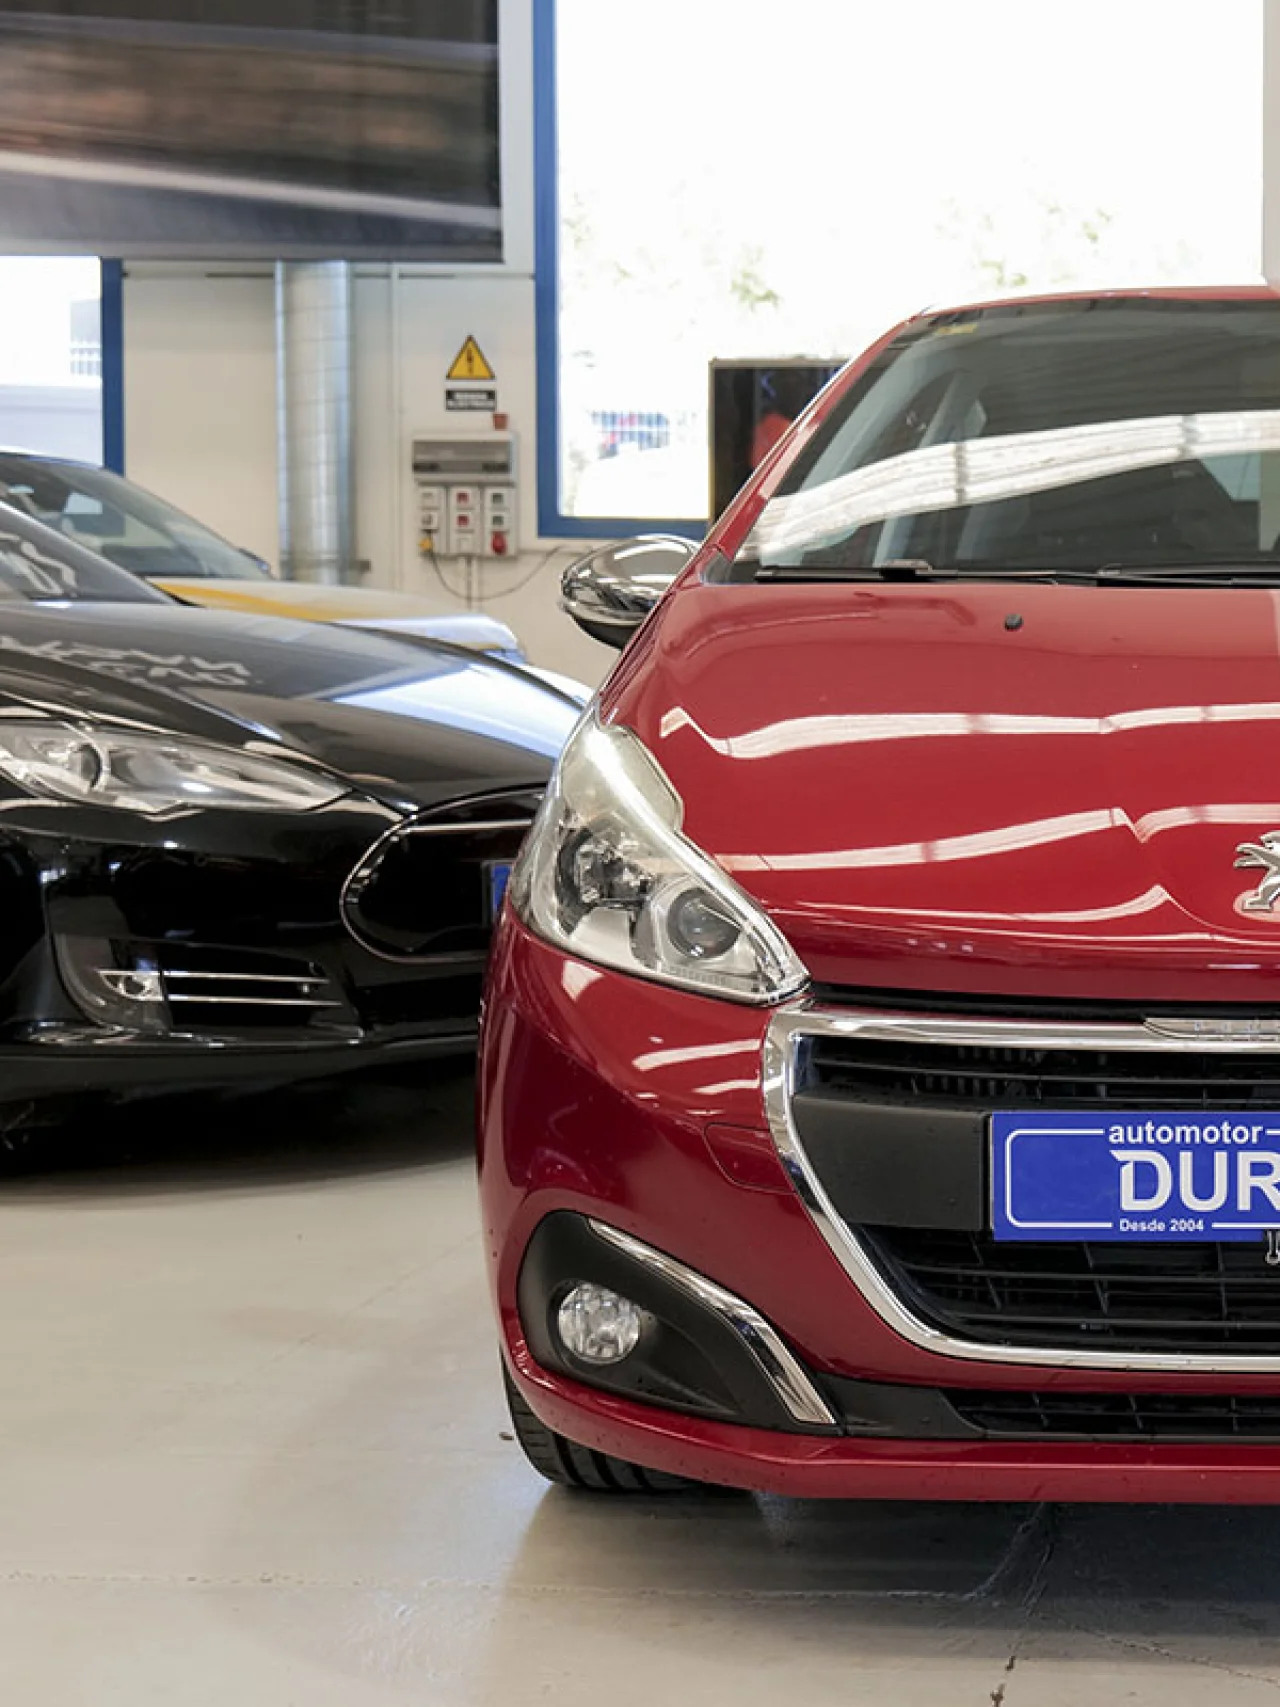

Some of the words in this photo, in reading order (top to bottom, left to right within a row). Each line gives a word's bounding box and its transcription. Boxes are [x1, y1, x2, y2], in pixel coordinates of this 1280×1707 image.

[1108, 1121, 1264, 1145] automotor
[1119, 1218, 1166, 1232] Desde
[1169, 1218, 1204, 1232] 2004
